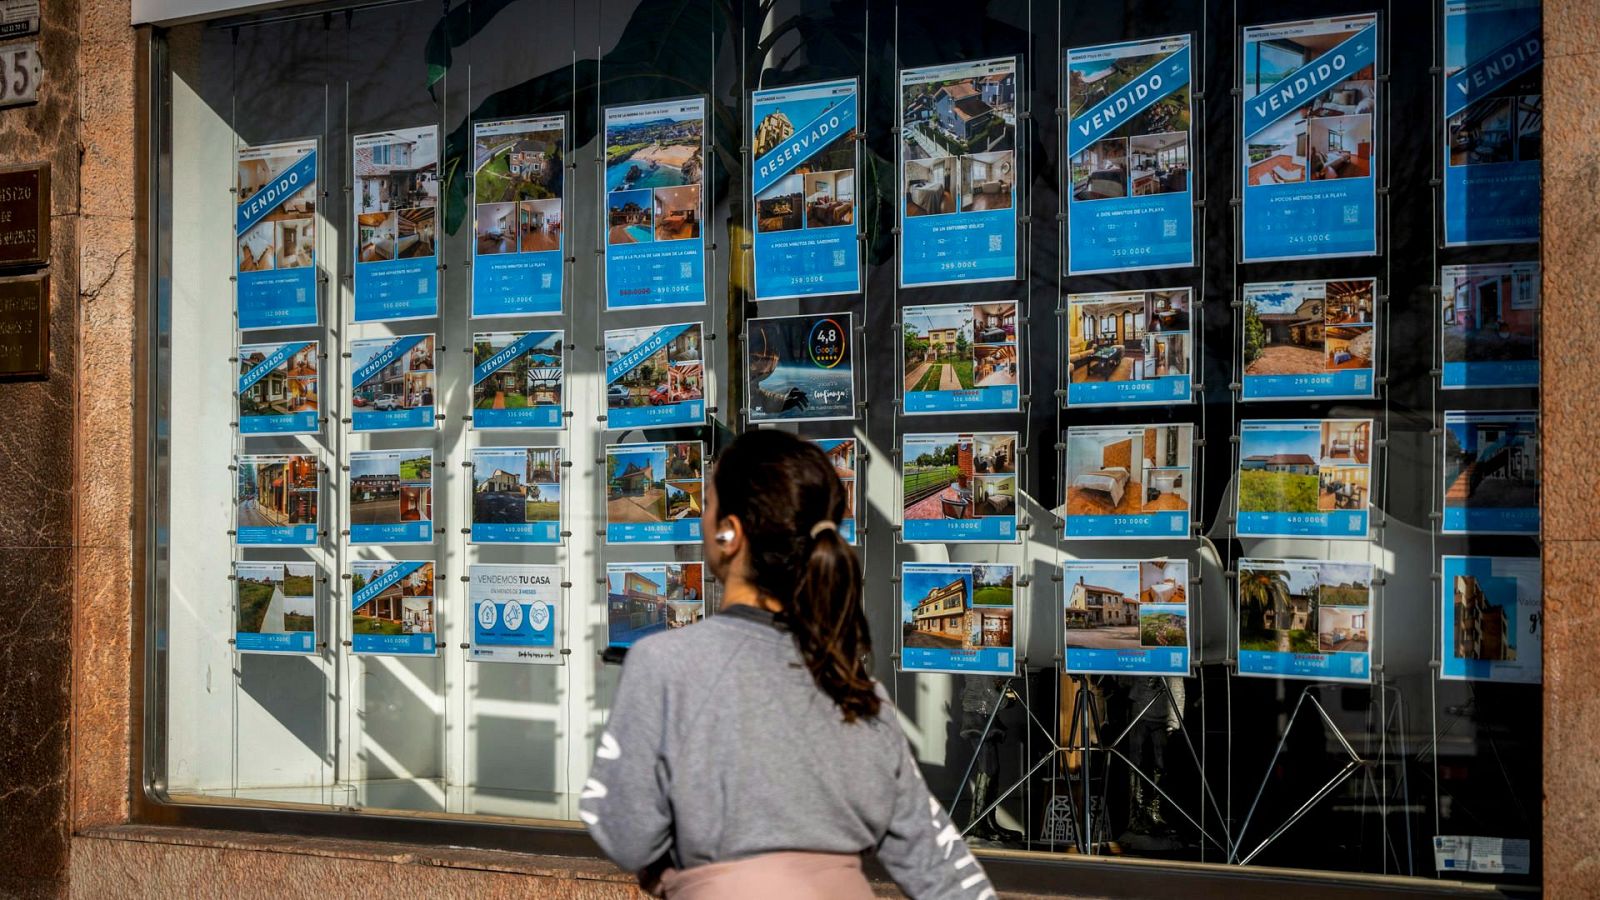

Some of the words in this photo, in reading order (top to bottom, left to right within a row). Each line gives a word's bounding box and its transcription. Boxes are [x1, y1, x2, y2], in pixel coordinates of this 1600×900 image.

[1255, 54, 1346, 118] VENDIDO
[1078, 74, 1162, 136] VENDIDO
[760, 116, 840, 178] RESERVADO
[242, 172, 298, 220] VENDIDO
[816, 345, 838, 355] Google
[817, 329, 836, 344] 4,8
[244, 352, 284, 385] RESERVADO
[360, 351, 392, 377] VENDIDO
[482, 346, 516, 373] VENDIDO
[612, 337, 662, 375] RESERVADO
[357, 571, 399, 602] RESERVADO
[478, 575, 517, 584] VENDEMOS
[519, 576, 529, 584] TU
[530, 576, 550, 584] CASA
